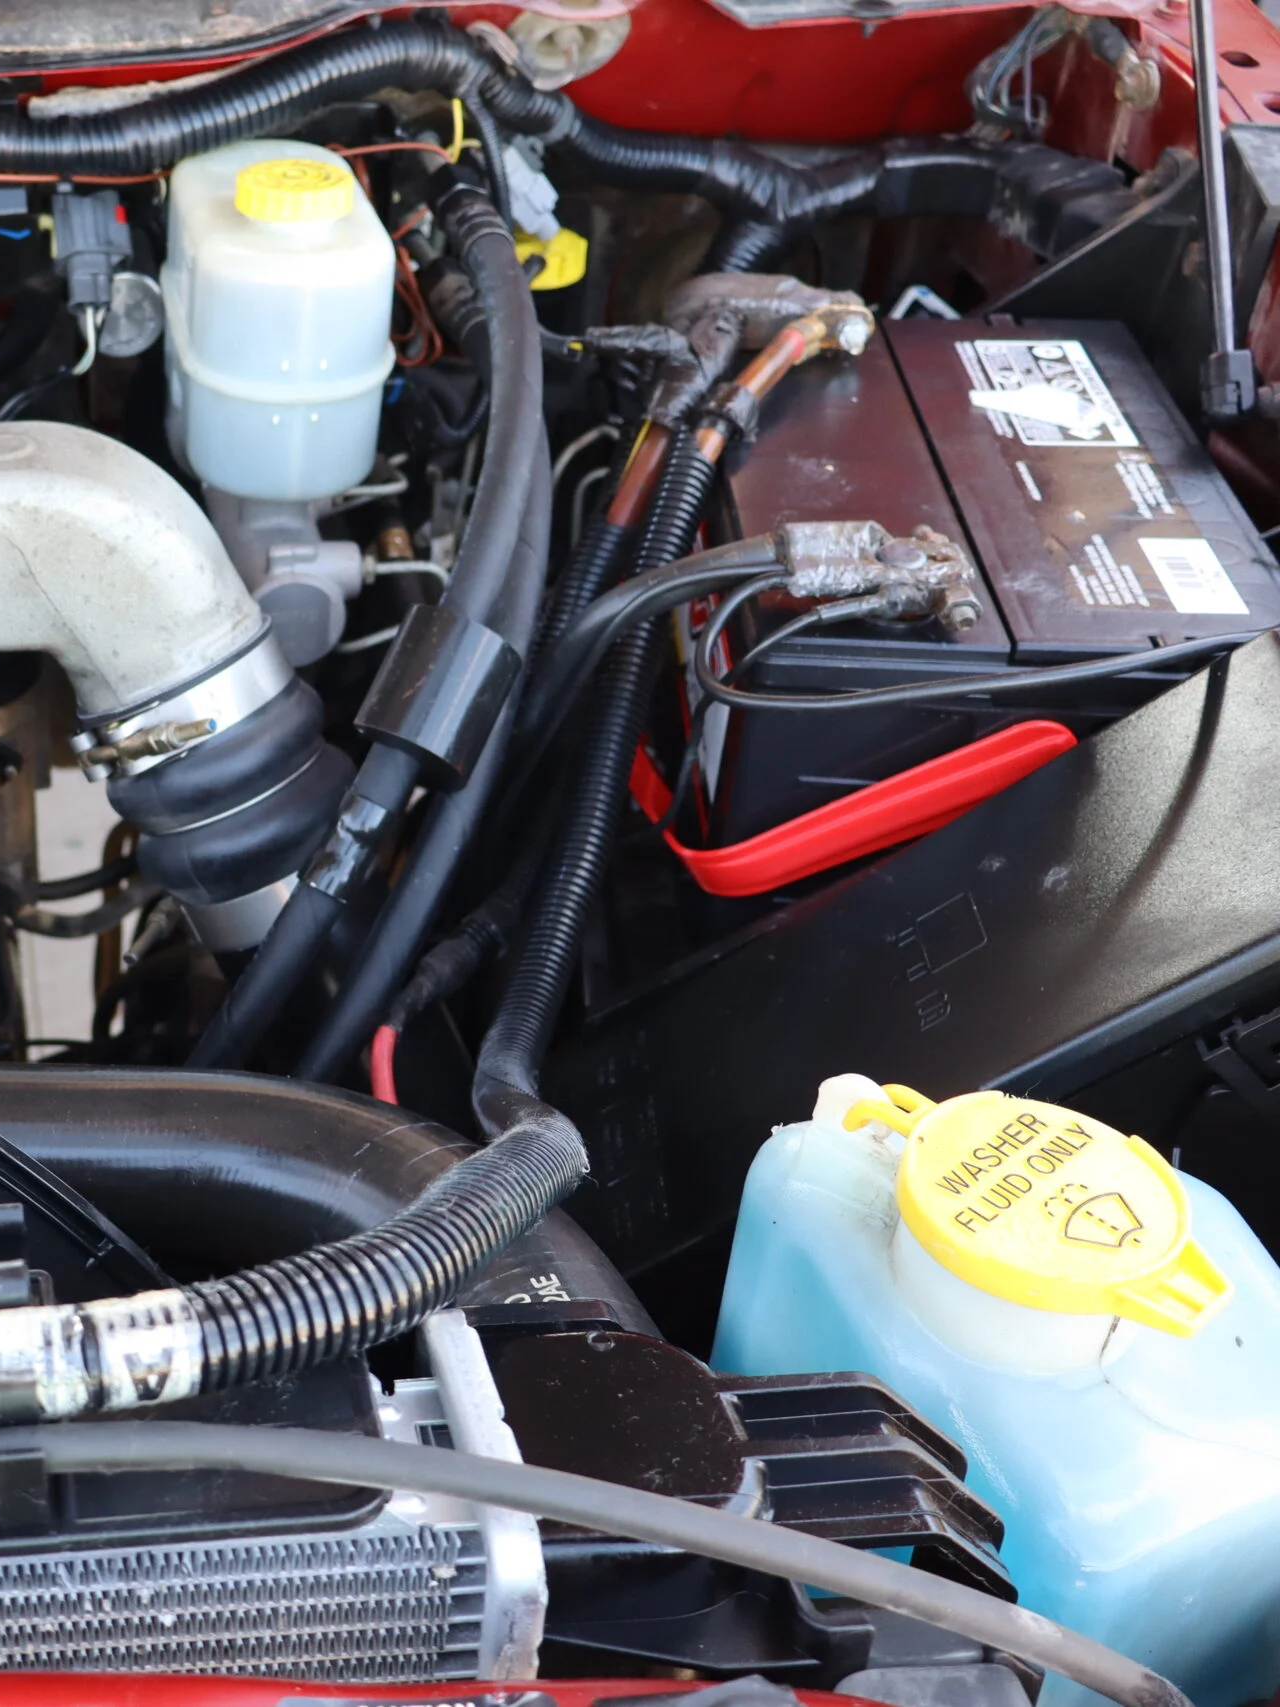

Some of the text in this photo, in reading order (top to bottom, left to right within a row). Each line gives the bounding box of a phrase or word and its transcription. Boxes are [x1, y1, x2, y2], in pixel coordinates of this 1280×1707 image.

[935, 1112, 1049, 1197] WASHER
[954, 1121, 1096, 1235] FLUID ONLY
